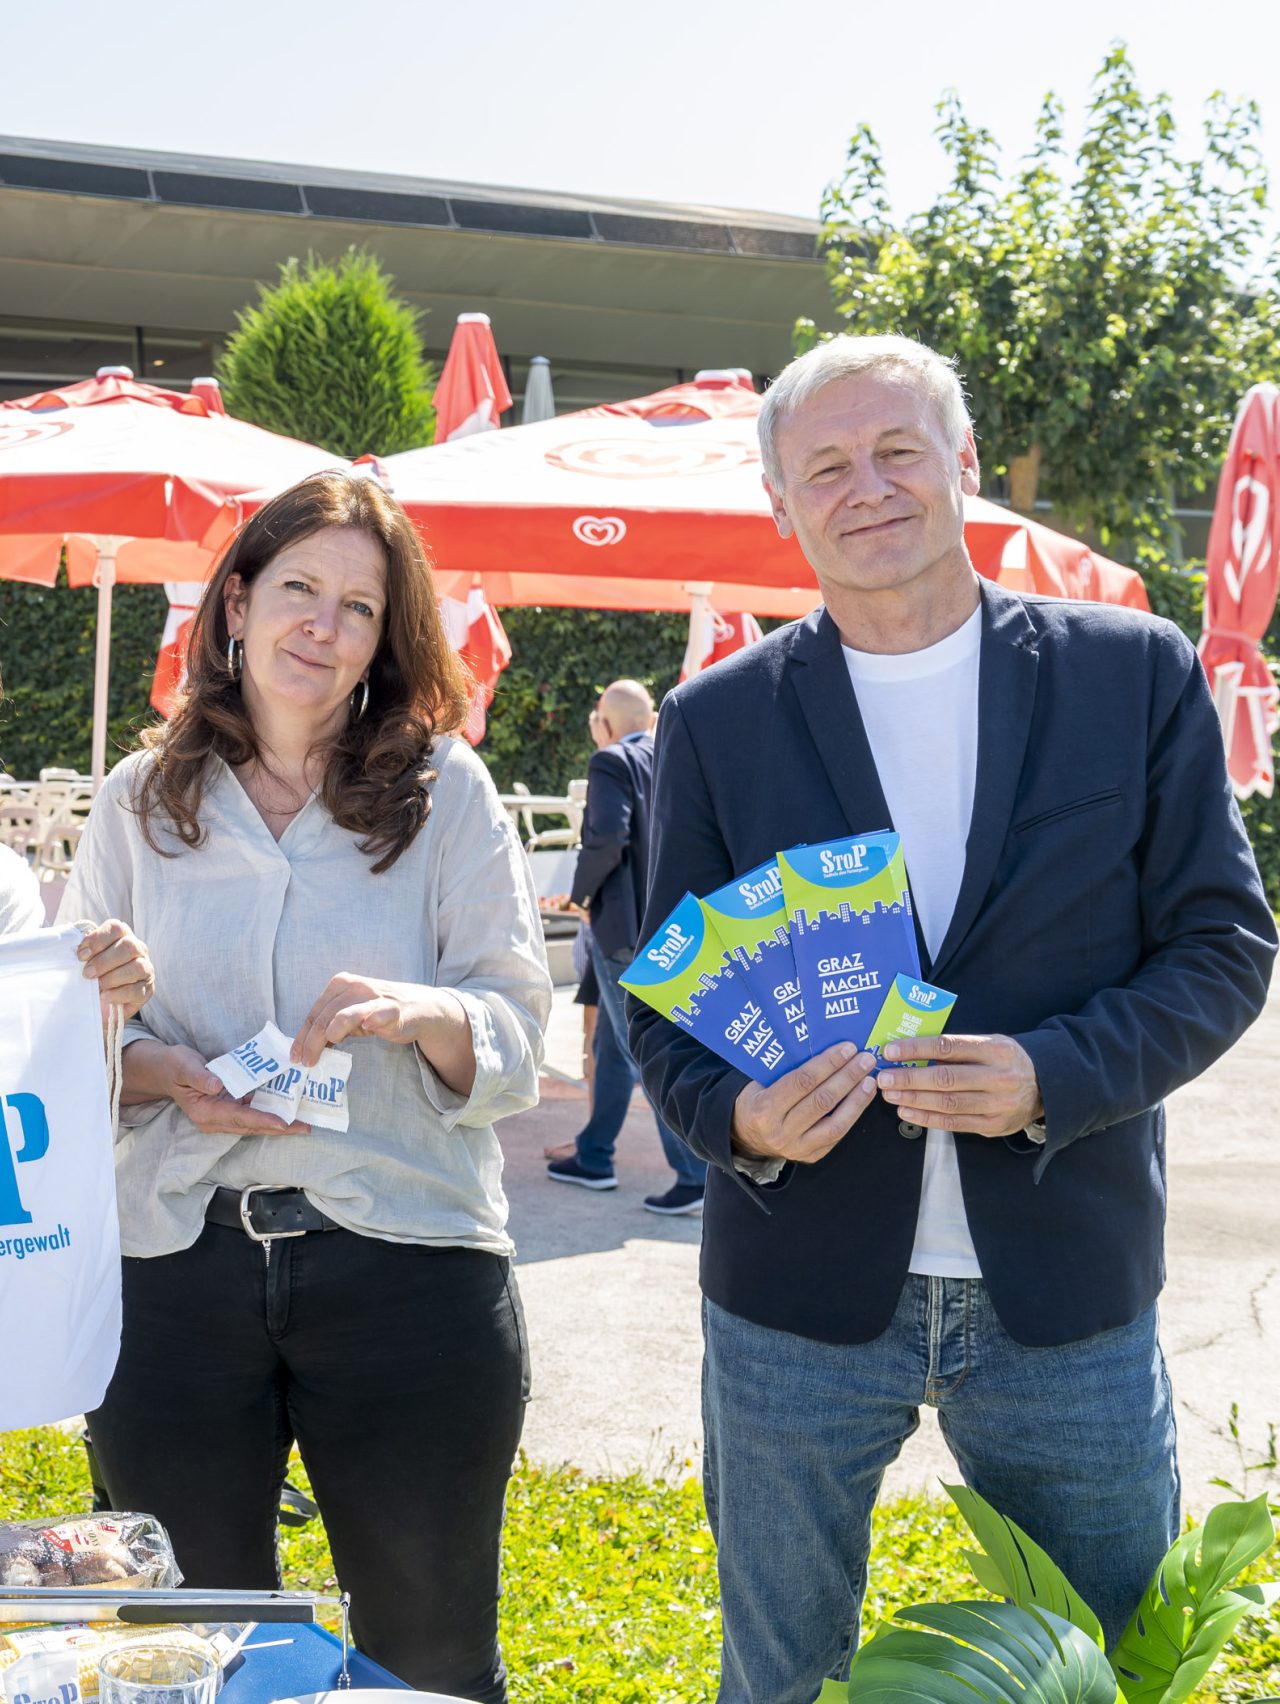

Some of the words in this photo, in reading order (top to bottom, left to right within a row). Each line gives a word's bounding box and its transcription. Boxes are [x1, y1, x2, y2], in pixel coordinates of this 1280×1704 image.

[817, 952, 864, 973] GRAZ
[822, 971, 879, 995] MACHT
[825, 996, 859, 1015] MIT!
[724, 1000, 760, 1041] GRAZ
[742, 1017, 772, 1055] MAC
